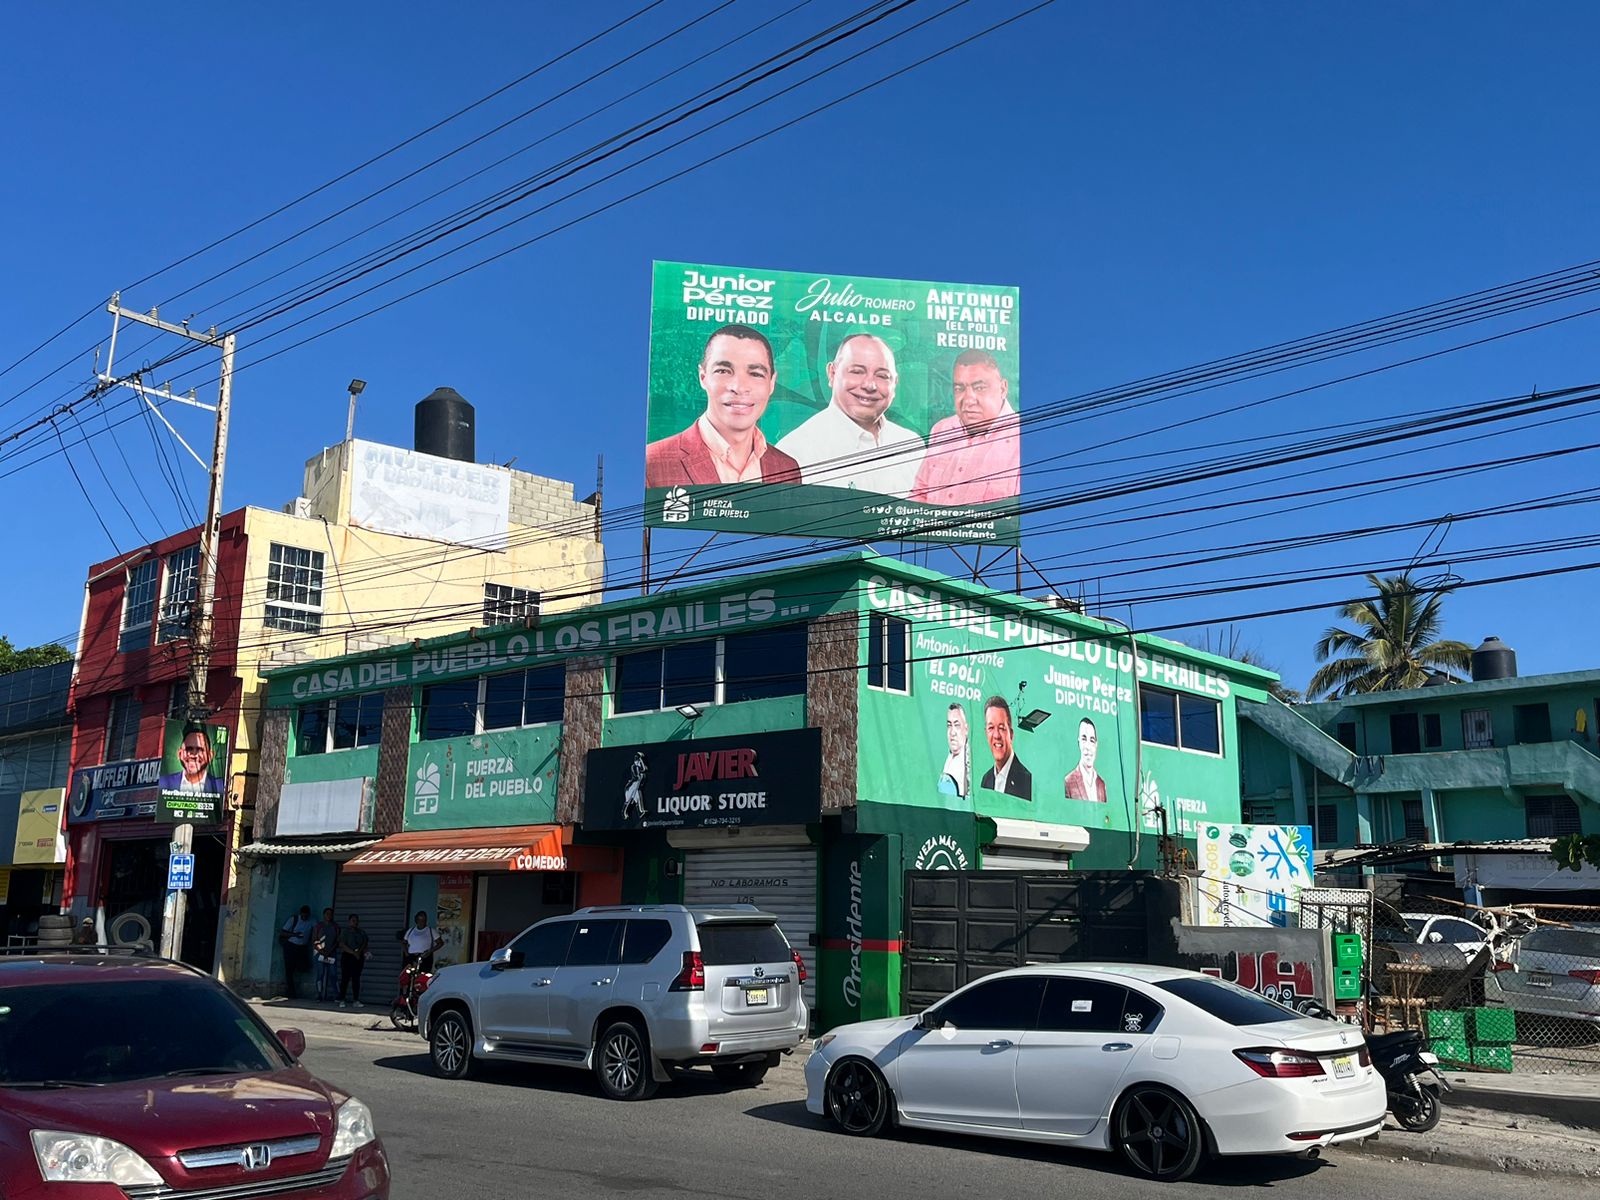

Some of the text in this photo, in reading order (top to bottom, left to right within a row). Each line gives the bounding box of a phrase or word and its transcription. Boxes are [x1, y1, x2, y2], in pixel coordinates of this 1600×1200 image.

[682, 270, 776, 293] Junior
[682, 287, 773, 309] Pérez
[794, 278, 916, 312] Julio ROMERO
[926, 288, 1014, 309] ANTONIO
[686, 306, 769, 325] DIPUTADO
[809, 310, 892, 326] ALCALDE
[927, 305, 1011, 325] INFANTE
[945, 321, 964, 331] (EL
[936, 332, 1007, 351] REGIDOR
[364, 446, 500, 488] MUFFLER
[364, 462, 379, 479] Y
[702, 499, 733, 509] FUERZA
[702, 508, 750, 519] DEL PUEBLO
[867, 575, 1230, 699] CASA DEL PUEBLO LOS FRAILES
[916, 633, 960, 656] Antonio
[292, 667, 353, 699] CASA
[359, 658, 407, 688] DEL
[412, 635, 529, 678] PUEBLO
[535, 621, 602, 658] LOS
[930, 679, 982, 702] REGIDOR
[1043, 664, 1132, 703] Junior Pérez
[1055, 688, 1118, 717] DIPUTADO
[91, 765, 129, 790] MUFFLER
[130, 764, 137, 785] Y
[466, 757, 514, 777] FUERZA
[673, 748, 759, 791] JAVIER
[465, 777, 543, 799] DEL PUEBLO
[415, 798, 437, 813] FP
[657, 791, 767, 816] LIQUOR STORE
[1176, 797, 1207, 814] FUERZA
[355, 847, 524, 863] LA COCINA DE DENY
[516, 854, 568, 870] COMEDOR
[915, 836, 938, 870] RVEZA
[938, 834, 957, 851] MÁS
[710, 878, 789, 887] NO LABORAMOS
[736, 896, 755, 904] LOS
[843, 861, 862, 1007] Presidente
